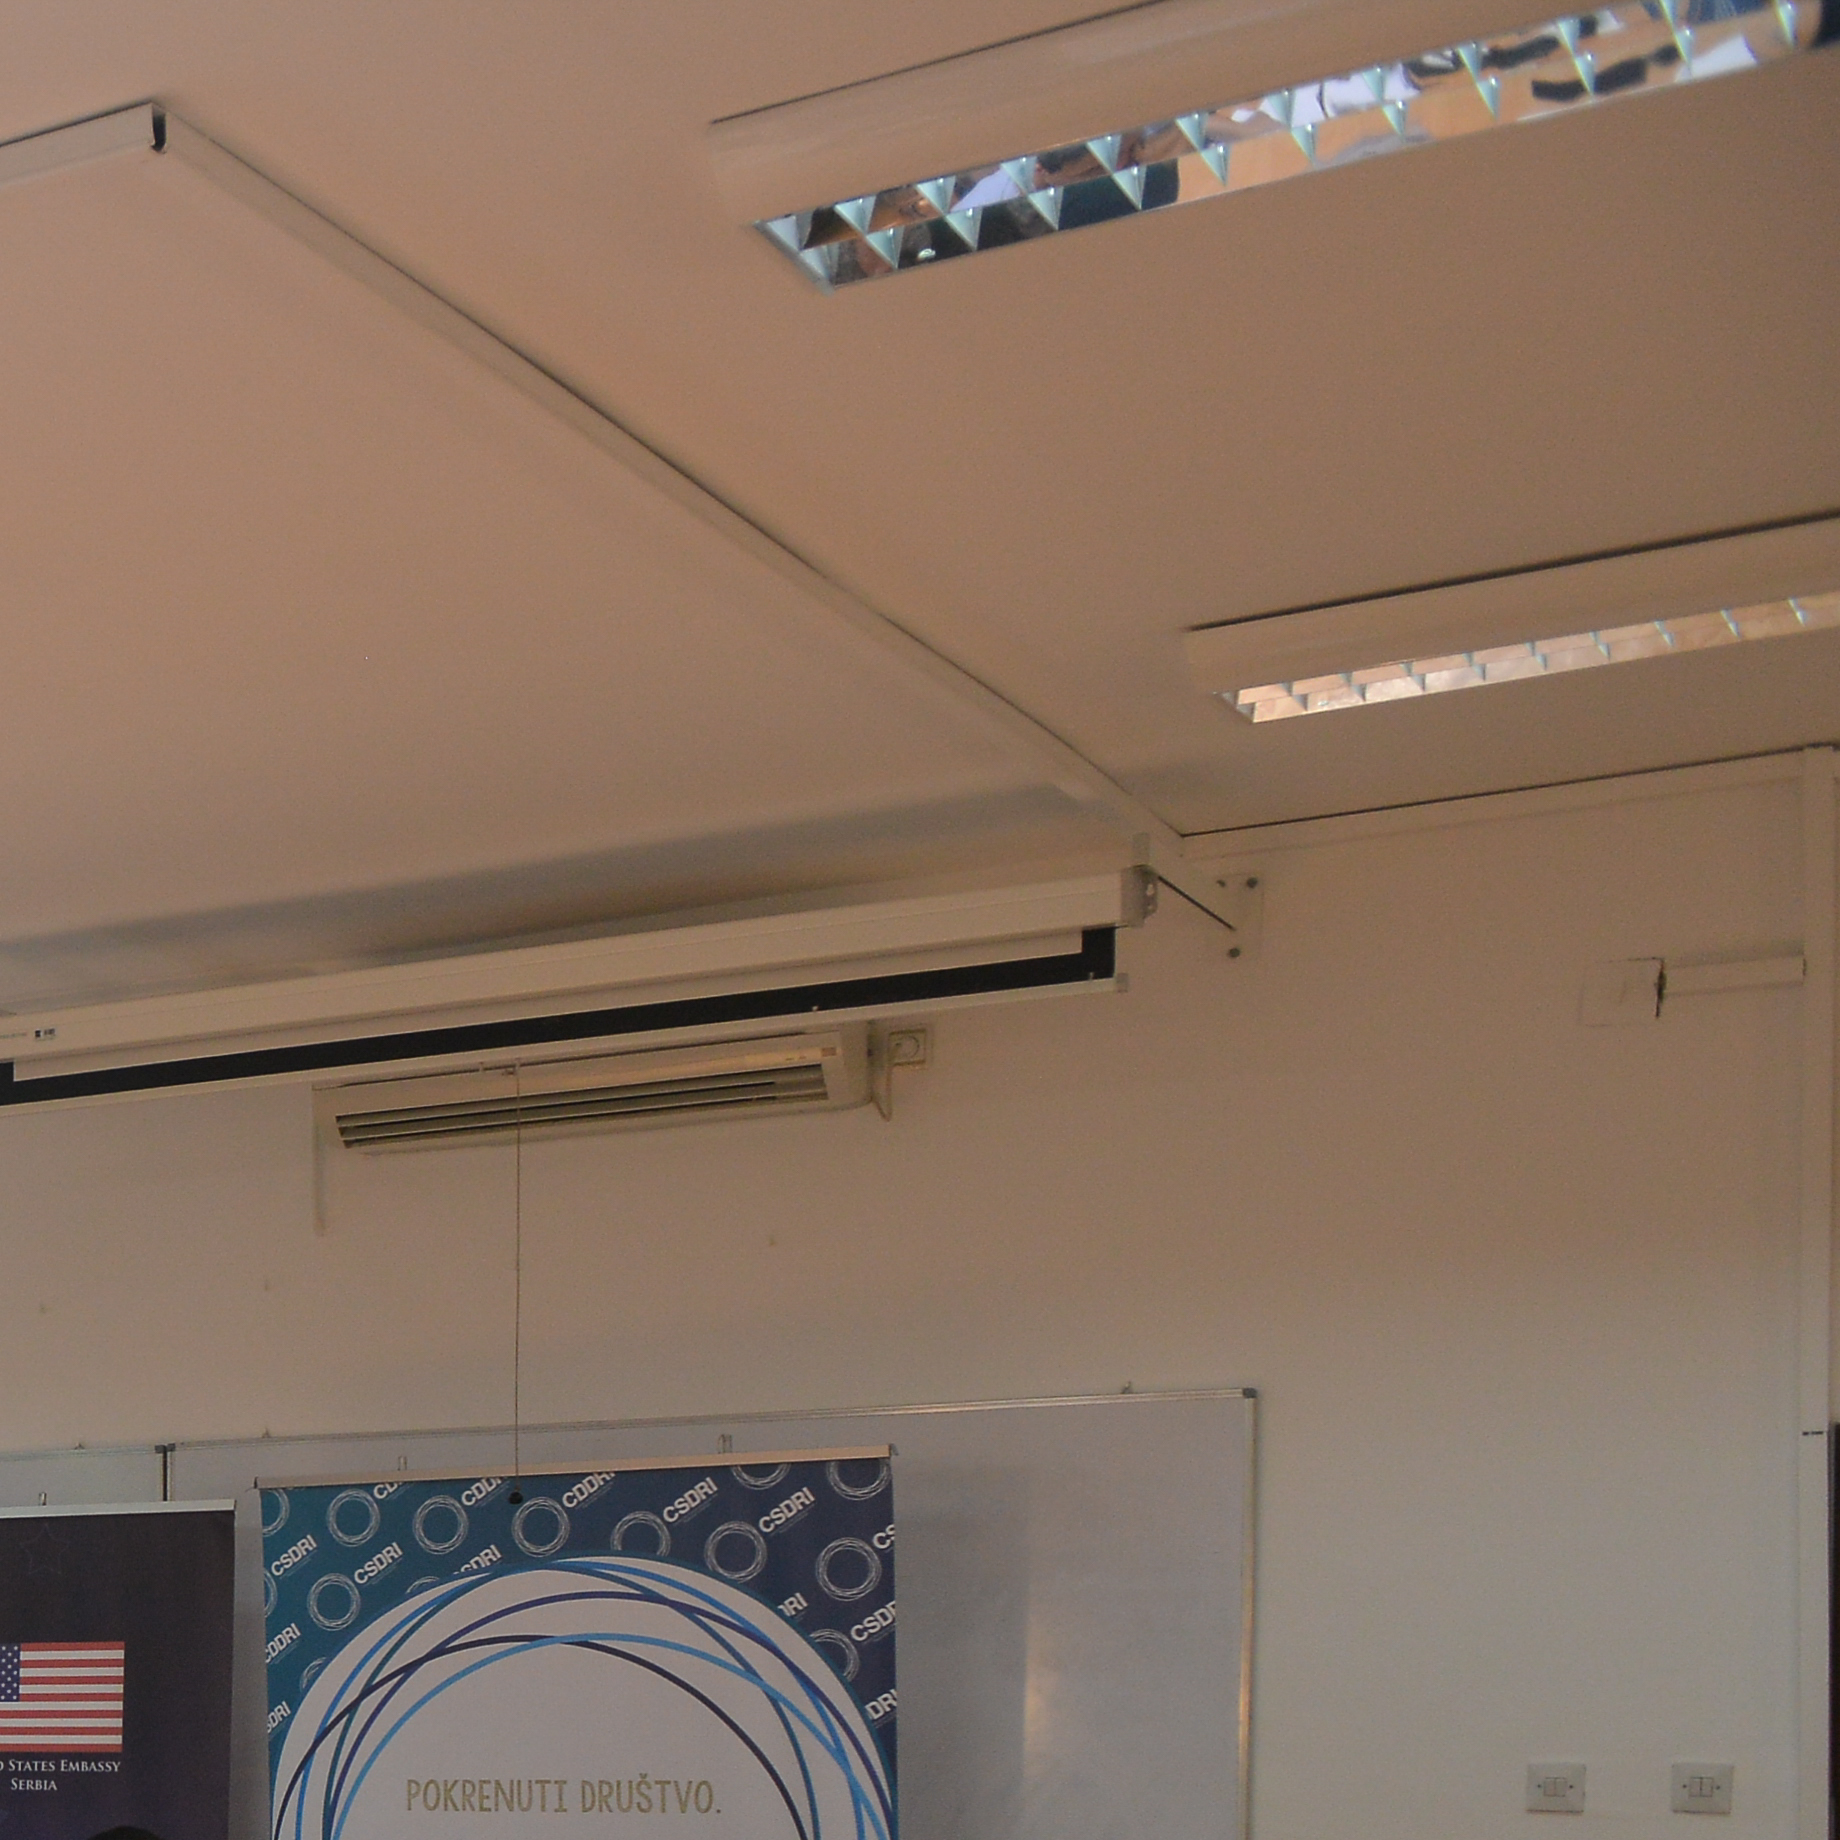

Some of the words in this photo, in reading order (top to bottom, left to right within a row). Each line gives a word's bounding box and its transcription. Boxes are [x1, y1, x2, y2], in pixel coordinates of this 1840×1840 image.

[663, 1477, 718, 1523] CSDRI
[759, 1487, 815, 1533] CSDRI
[271, 1534, 318, 1577] CSDRI
[354, 1542, 403, 1585] CSDRI
[8, 1759, 56, 1772] STATES
[60, 1759, 121, 1772] EMBASSY
[10, 1777, 58, 1791] SERBIA
[406, 1779, 567, 1813] POKRENUTI
[581, 1773, 722, 1814] DRUŠTVO.
